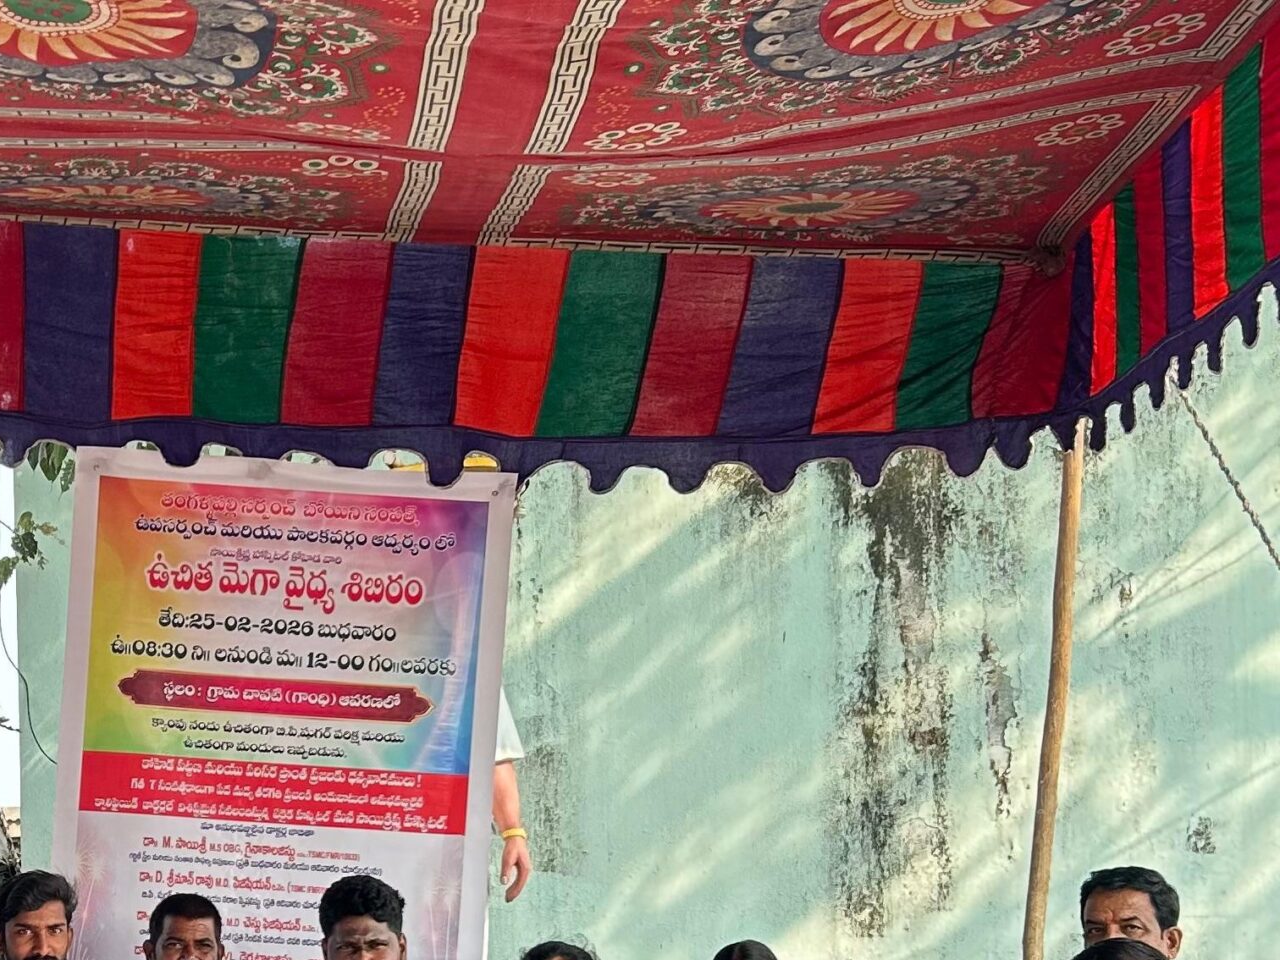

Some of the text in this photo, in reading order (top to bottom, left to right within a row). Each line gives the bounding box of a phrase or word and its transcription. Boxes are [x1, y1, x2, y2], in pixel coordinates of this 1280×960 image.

[241, 496, 297, 519] సర్పంచ్
[135, 514, 217, 539] ఉపసర్పంచ్
[220, 521, 283, 540] మరియు
[286, 526, 367, 549] పాలకవర్గం
[435, 532, 456, 550] లో
[147, 553, 213, 591] ఉచిత
[219, 561, 280, 596] మెగా
[341, 573, 423, 605] శిబిరం
[318, 623, 397, 642] బుధవారం
[215, 646, 273, 665] లనుండి
[306, 652, 365, 671] 12-00
[207, 685, 240, 703] గ్రామ
[339, 693, 402, 710] ఆవరణలో
[190, 720, 220, 732] నందు
[223, 720, 274, 735] ఉచితంగా
[362, 731, 406, 743] మరియు
[184, 736, 234, 751] ఉచితంగా
[236, 740, 285, 754] మందులు
[204, 761, 243, 776] మరియు
[149, 779, 158, 790] 7
